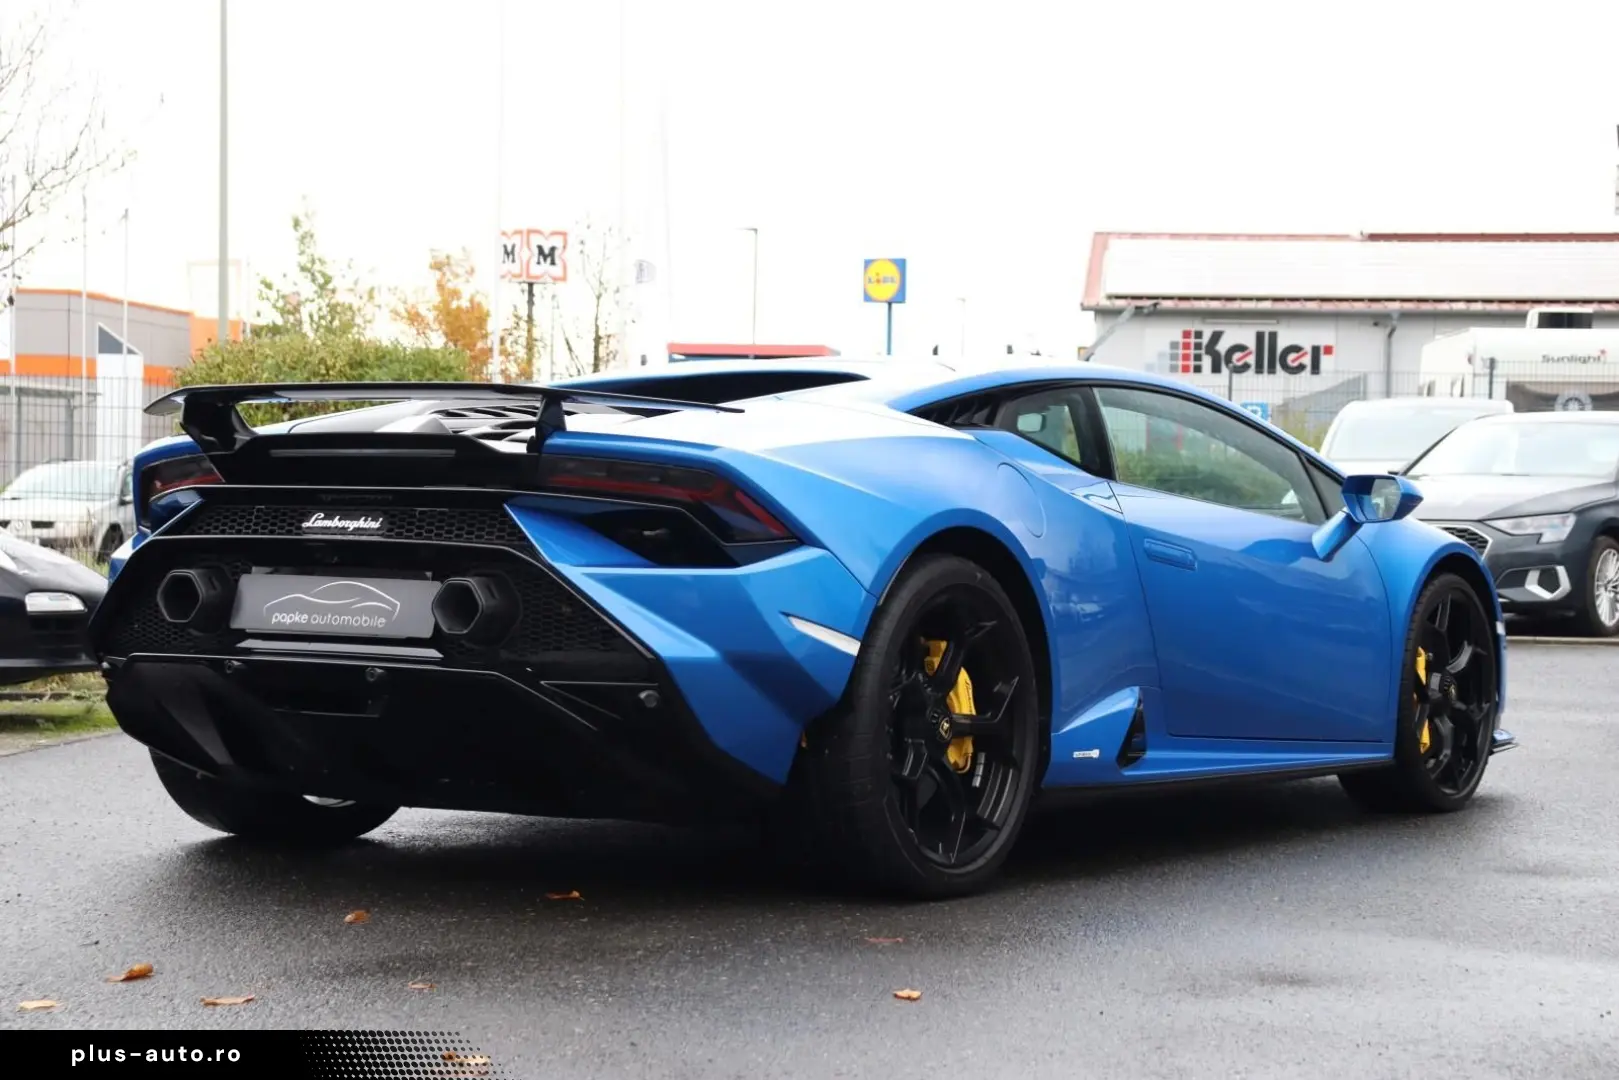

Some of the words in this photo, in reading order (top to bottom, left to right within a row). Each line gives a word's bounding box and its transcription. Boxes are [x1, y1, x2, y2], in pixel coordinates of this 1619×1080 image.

[502, 243, 516, 264] M
[536, 244, 558, 266] M
[1193, 330, 1333, 375] Keller
[1541, 354, 1607, 364] Sunlight
[302, 512, 383, 531] Lamborghini
[271, 611, 309, 624] papke
[310, 612, 386, 628] automobile
